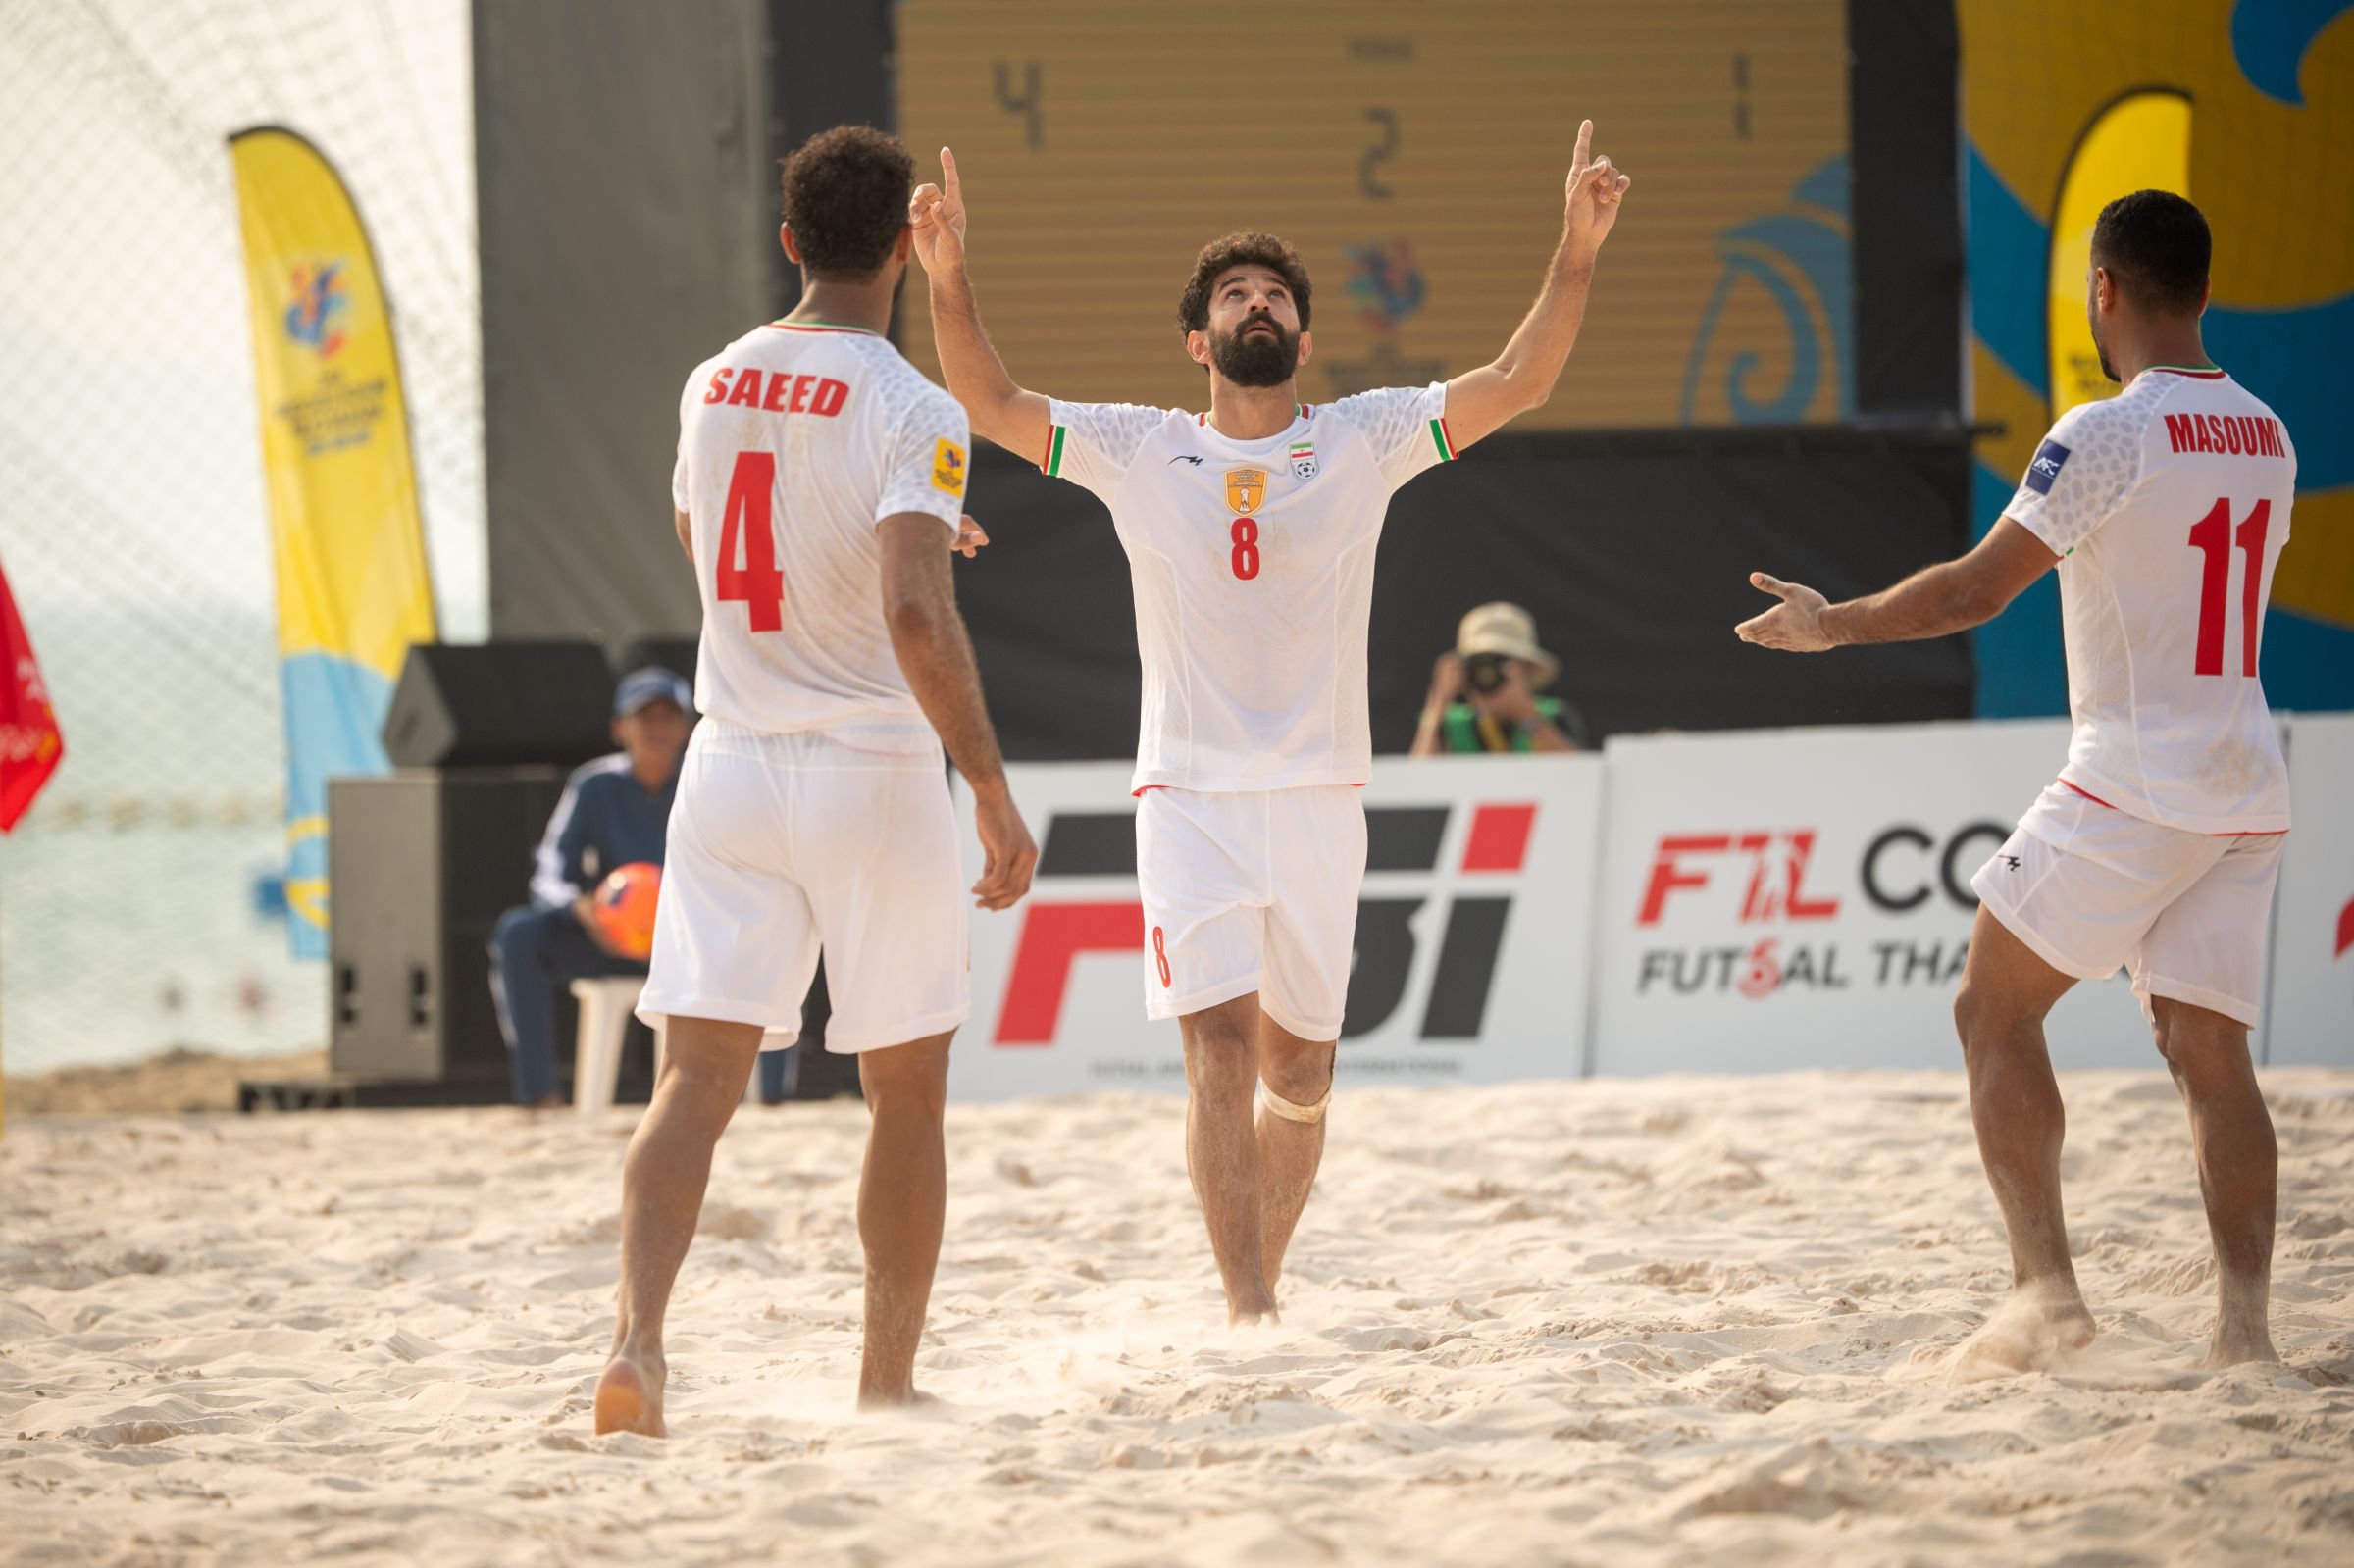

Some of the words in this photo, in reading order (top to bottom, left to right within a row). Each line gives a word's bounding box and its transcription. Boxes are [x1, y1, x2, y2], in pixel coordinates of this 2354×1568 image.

[1358, 106, 1401, 200] 2
[703, 367, 850, 418] SAEED
[2163, 413, 2286, 458] MASOUMI
[716, 450, 785, 633] 4
[1230, 517, 1260, 581] 8
[2187, 496, 2272, 678] 11
[1152, 925, 1172, 988] 8
